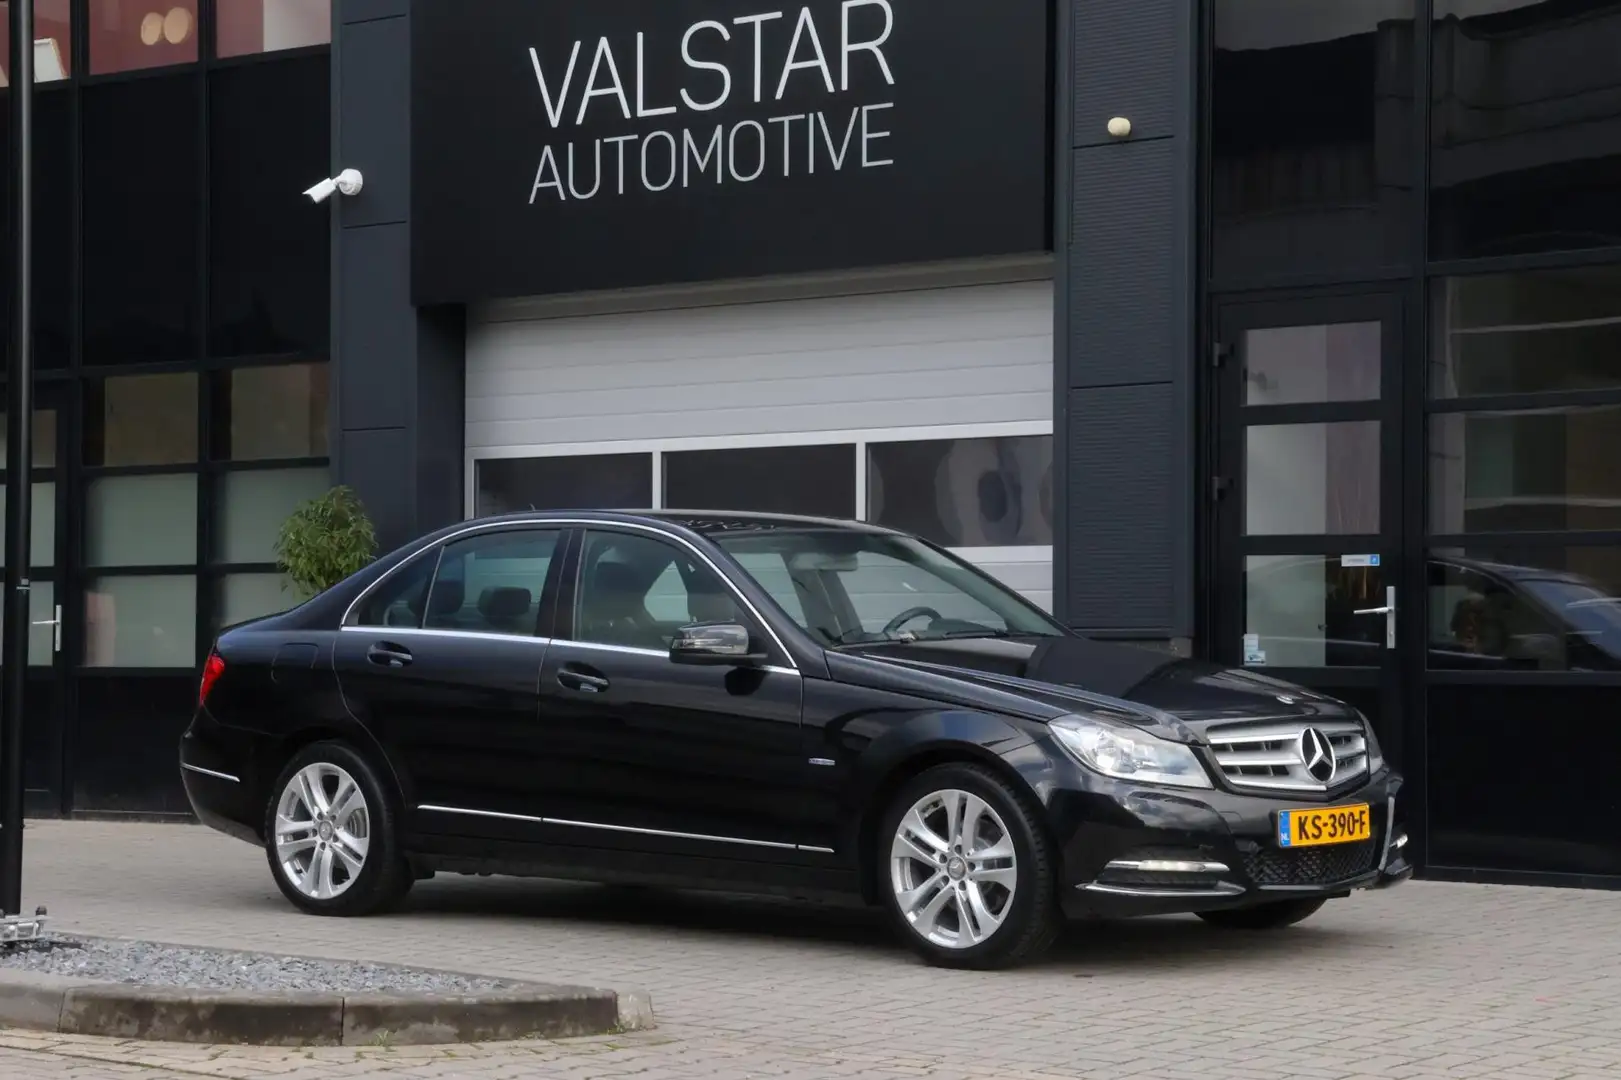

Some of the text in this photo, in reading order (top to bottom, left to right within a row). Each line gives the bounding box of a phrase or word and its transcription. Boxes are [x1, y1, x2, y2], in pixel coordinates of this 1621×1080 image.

[529, 0, 895, 128] VALSTAR
[529, 102, 894, 204] AUTOMOTIVE
[1298, 810, 1366, 841] KS-390-F
